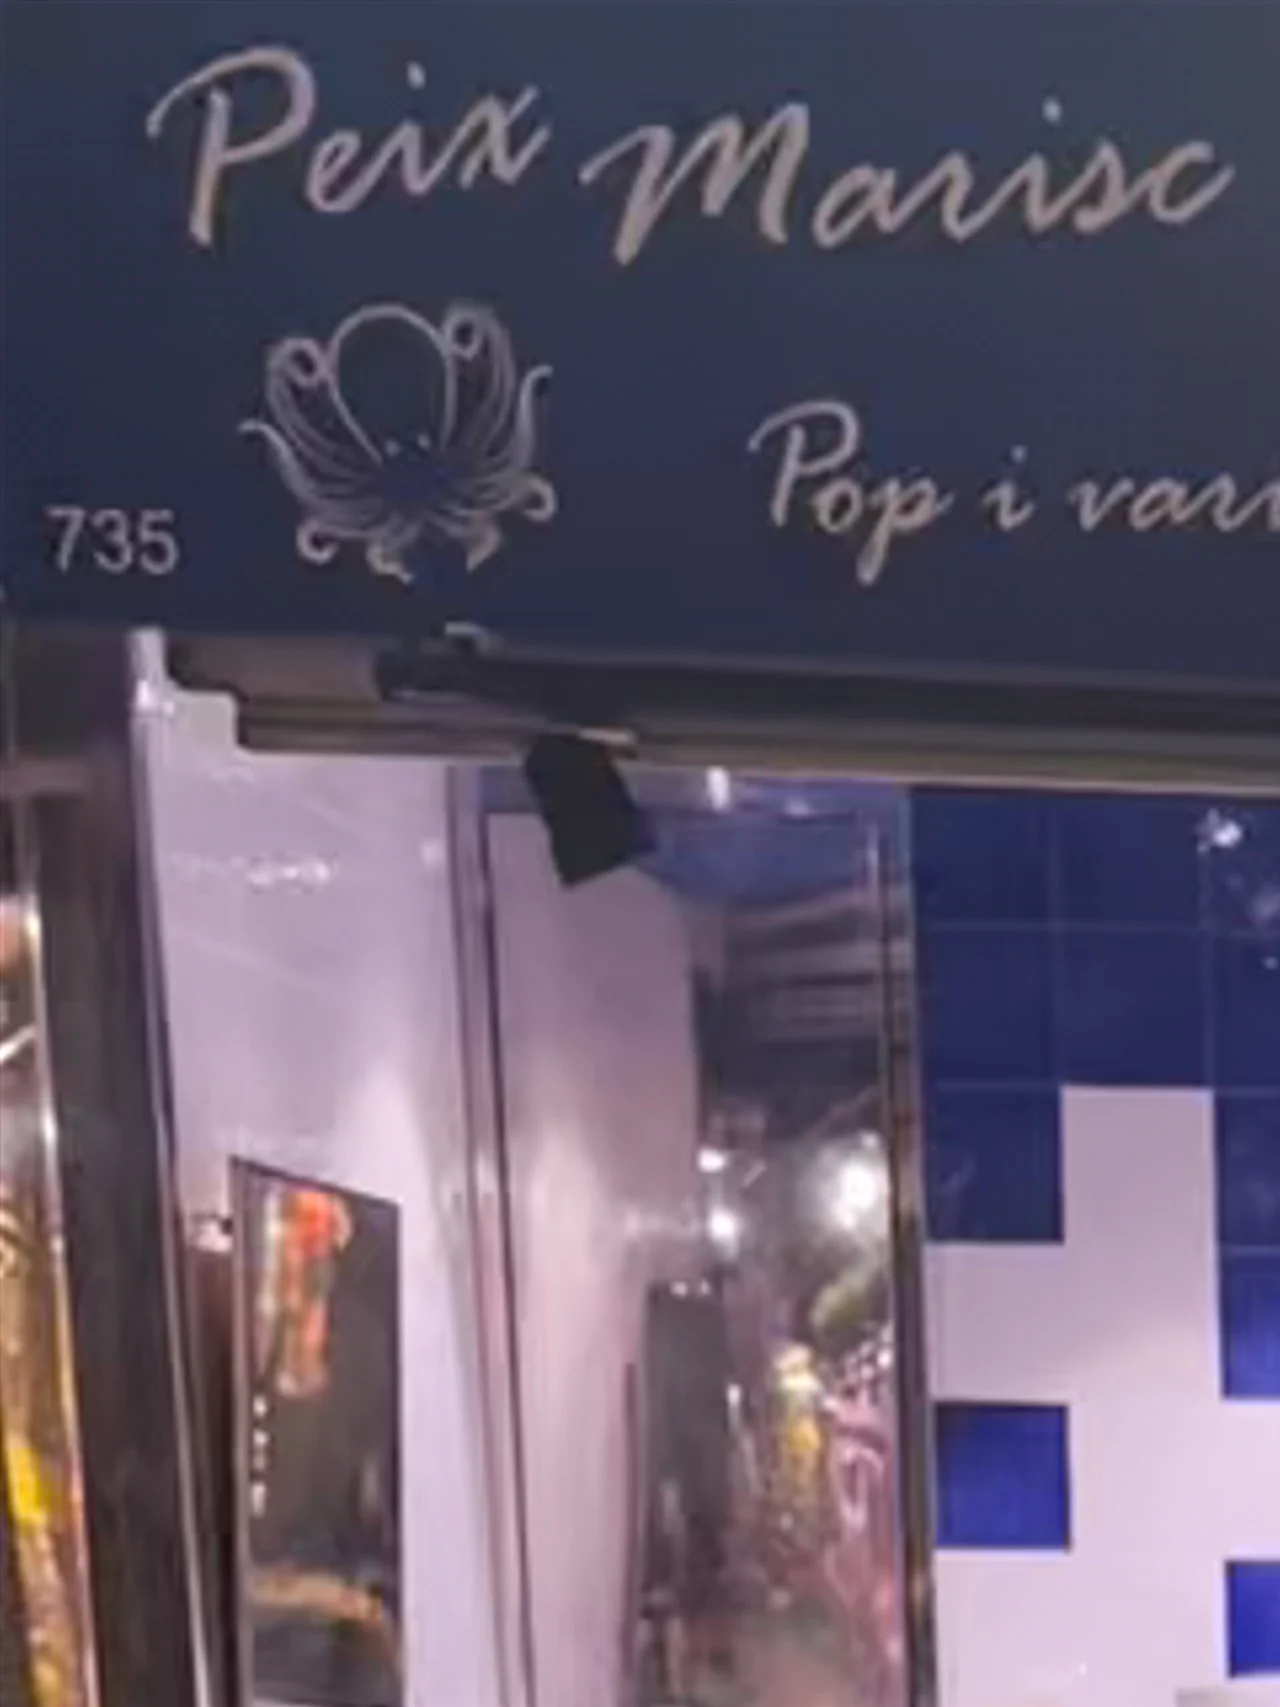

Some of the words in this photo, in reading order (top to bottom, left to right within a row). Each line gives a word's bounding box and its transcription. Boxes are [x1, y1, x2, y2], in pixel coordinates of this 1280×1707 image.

[145, 44, 552, 248] Peix
[578, 98, 1238, 268] Marisc
[48, 508, 180, 576] 735
[748, 400, 956, 586] Pop
[984, 446, 1036, 532] i
